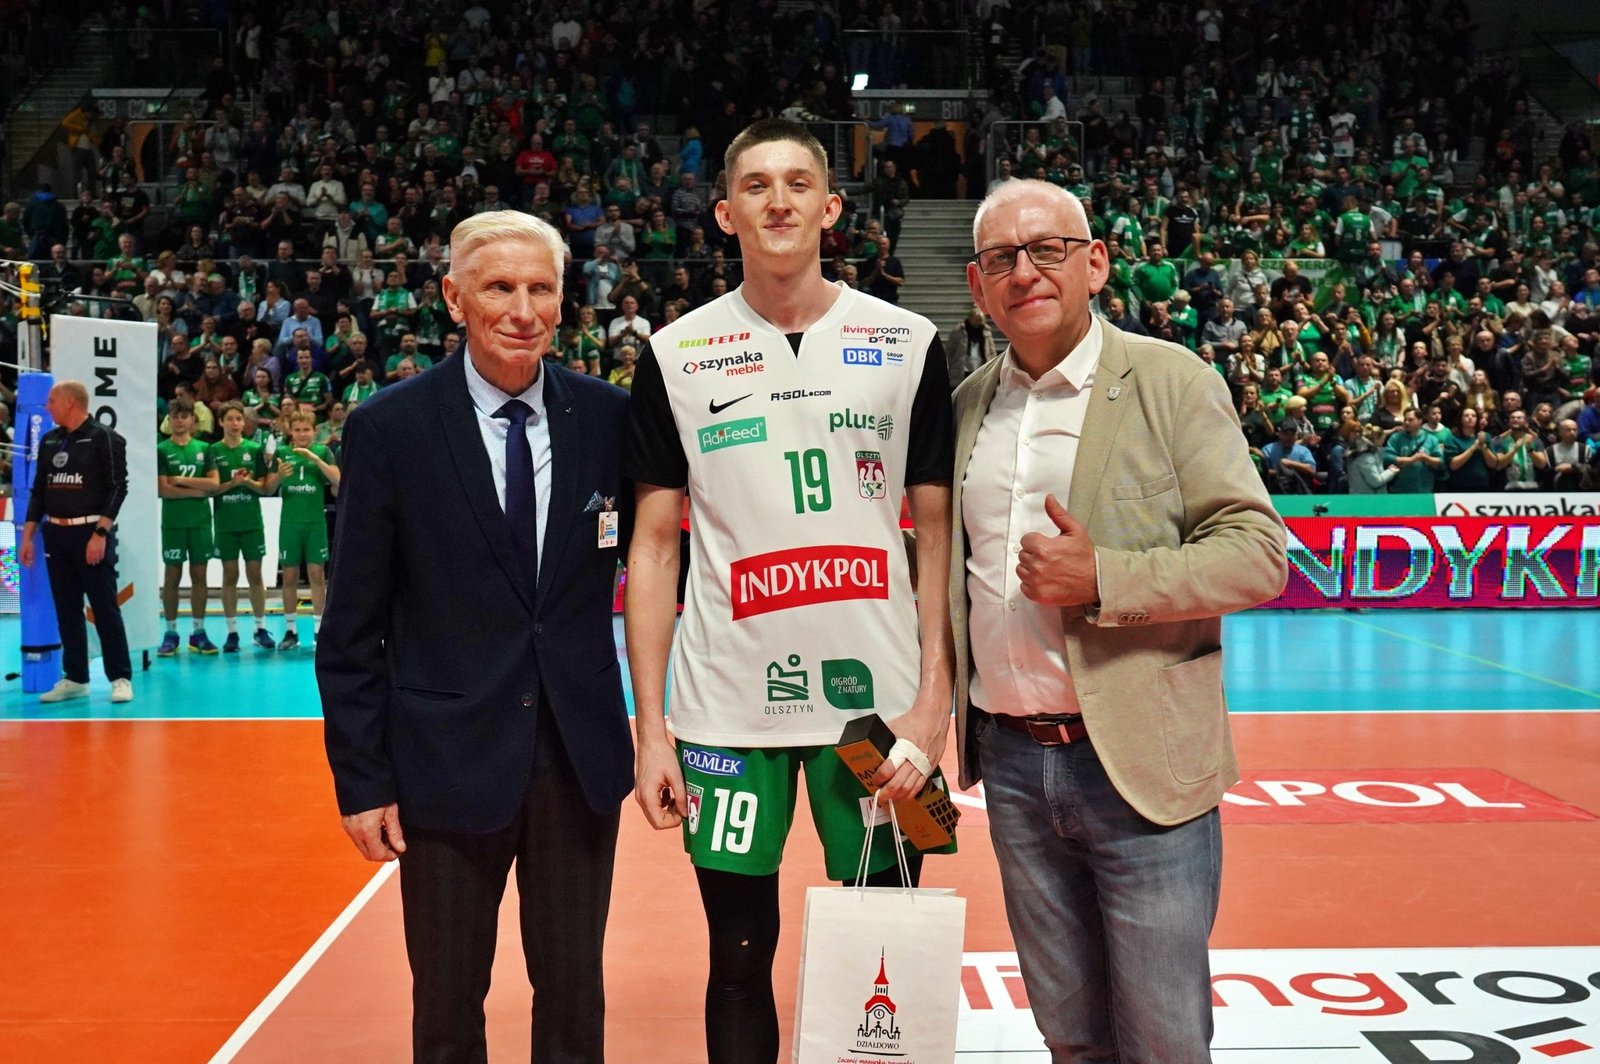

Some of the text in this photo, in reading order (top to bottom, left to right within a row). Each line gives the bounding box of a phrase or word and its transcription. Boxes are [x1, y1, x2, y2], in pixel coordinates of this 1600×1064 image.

[843, 325, 910, 336] livingroom
[679, 332, 750, 348] BIOFEED
[699, 351, 763, 371] szynaka
[847, 350, 879, 363] DBK
[726, 363, 764, 376] meble
[829, 408, 876, 432] plus
[784, 448, 832, 514] 19
[1286, 525, 1600, 597] NDYK
[740, 558, 884, 604] INDYKPOL
[843, 685, 867, 694] NATURY
[764, 704, 814, 715] OLSZTYN
[683, 749, 742, 774] POLMLEK
[710, 788, 758, 854] 19
[856, 1040, 900, 1050] DZIAŁDOWO
